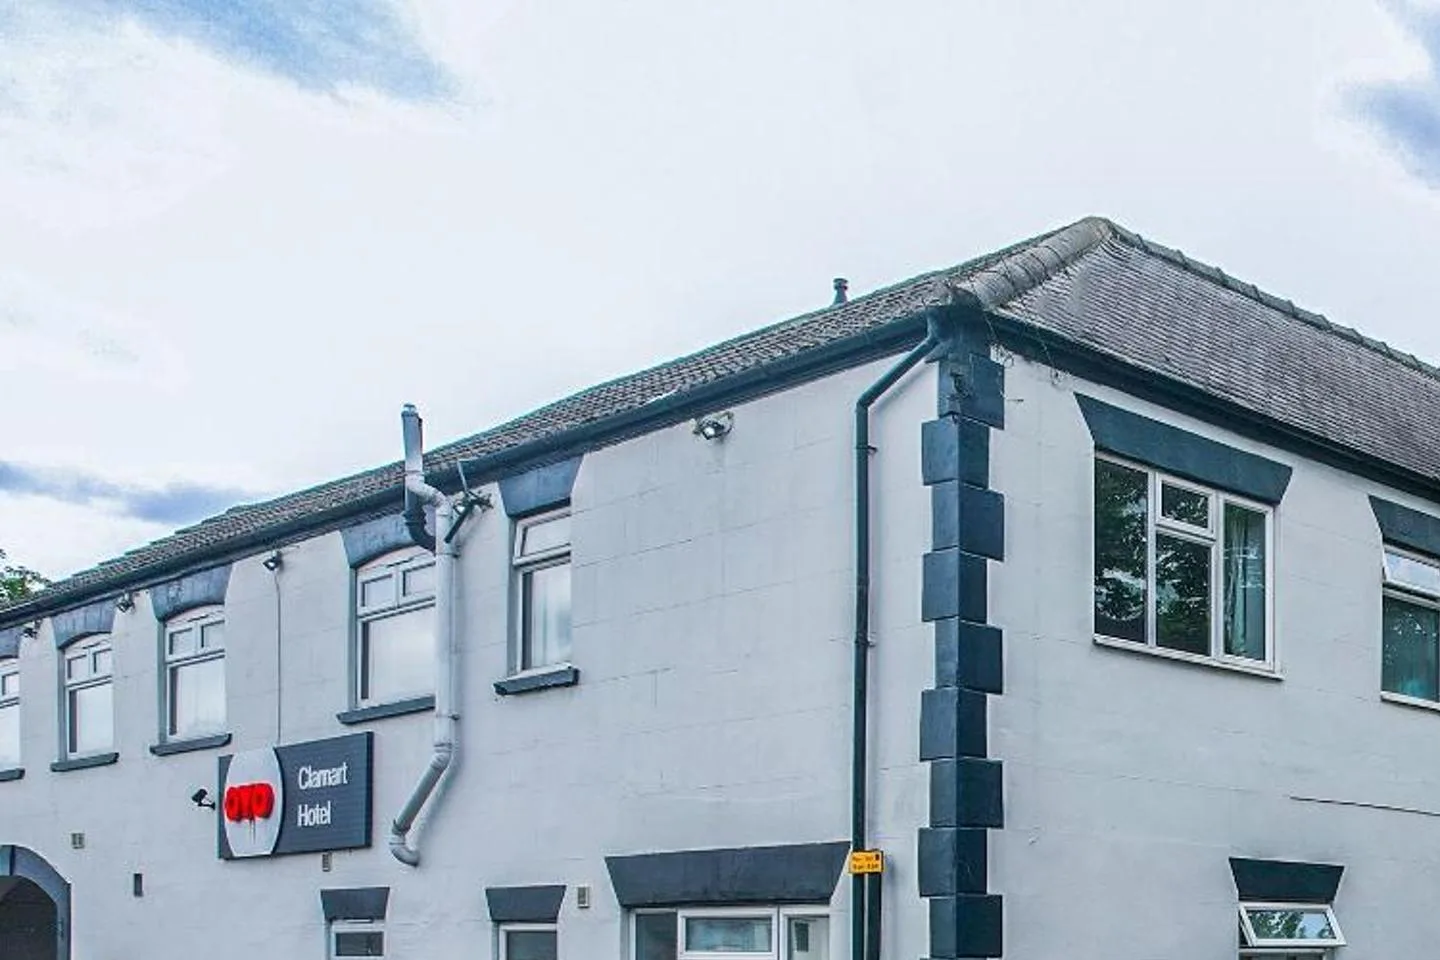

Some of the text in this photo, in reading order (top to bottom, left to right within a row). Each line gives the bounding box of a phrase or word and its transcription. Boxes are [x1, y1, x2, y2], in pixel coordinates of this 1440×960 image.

[298, 762, 348, 790] Clamart
[225, 783, 275, 822] OYO
[297, 800, 331, 827] Hotel
